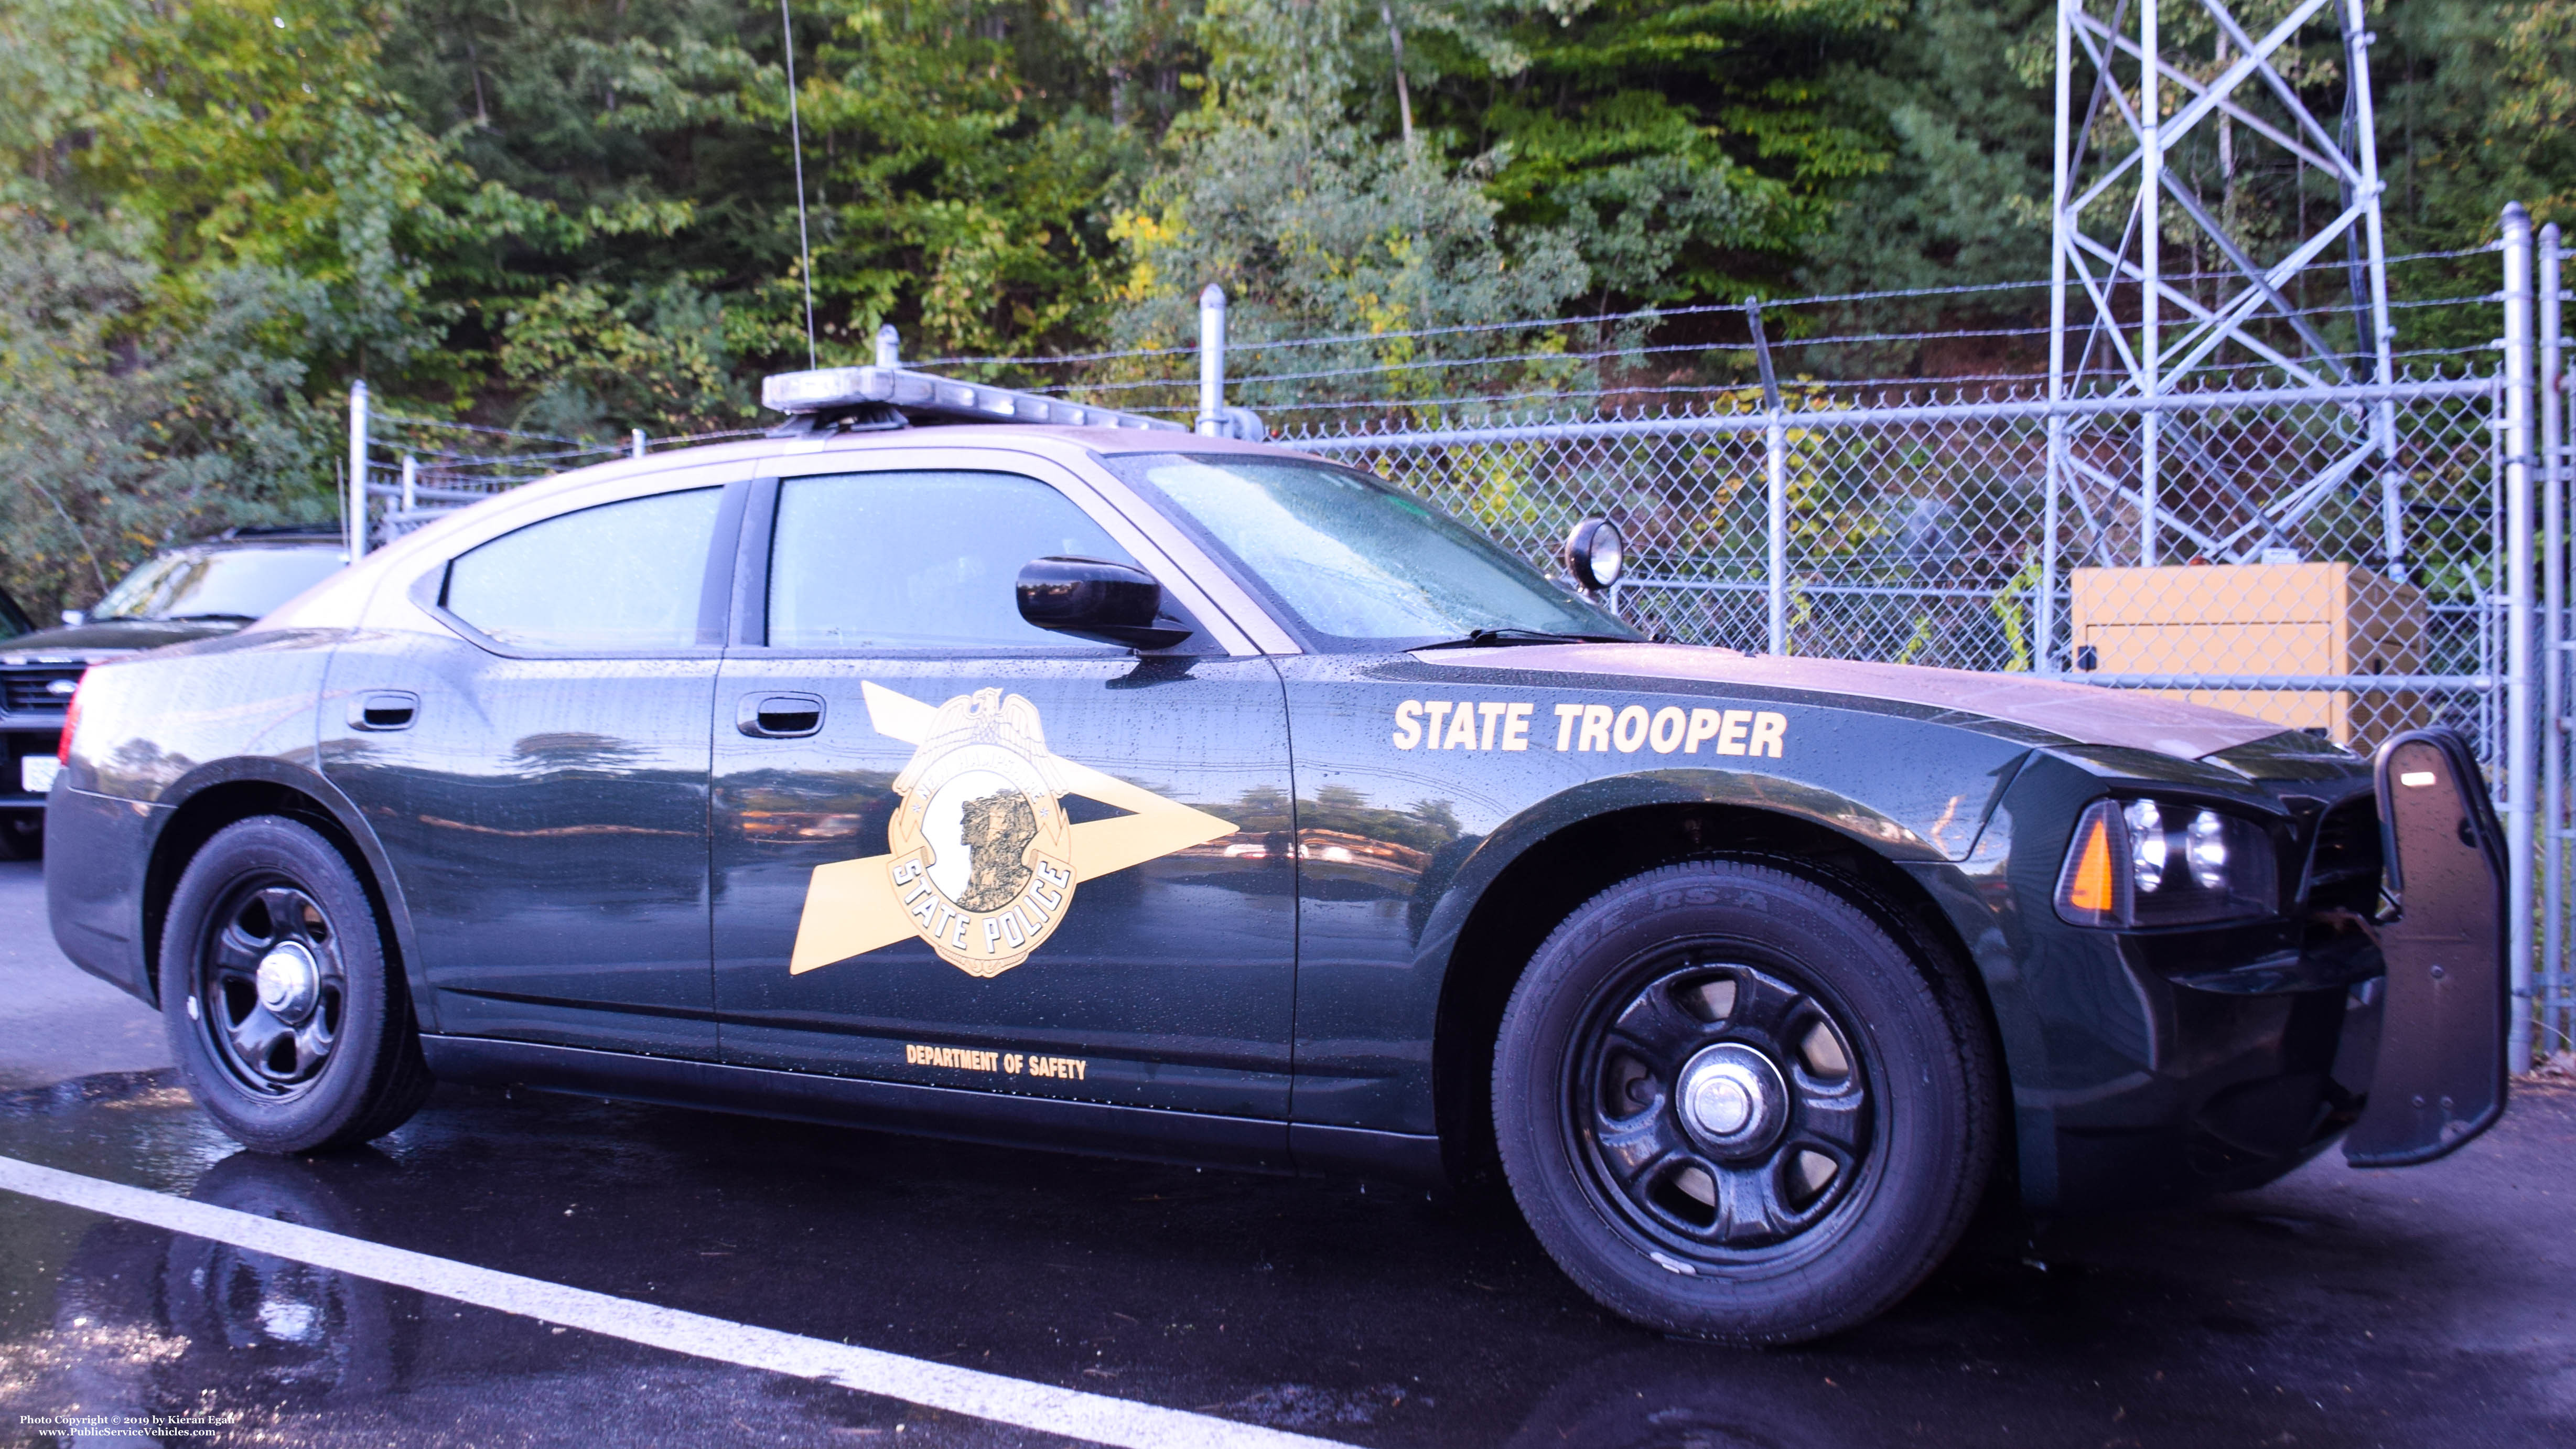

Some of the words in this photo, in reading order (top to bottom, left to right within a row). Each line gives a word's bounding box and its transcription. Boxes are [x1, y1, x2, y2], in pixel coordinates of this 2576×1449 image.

[1393, 700, 1534, 752] STATE
[1554, 703, 1788, 758] TROOPER
[892, 858, 971, 950] STATE
[982, 861, 1071, 954] POLICE
[906, 1044, 998, 1072] DEPARTMENT
[1004, 1053, 1023, 1075] OF
[1029, 1055, 1086, 1080] SAFETY
